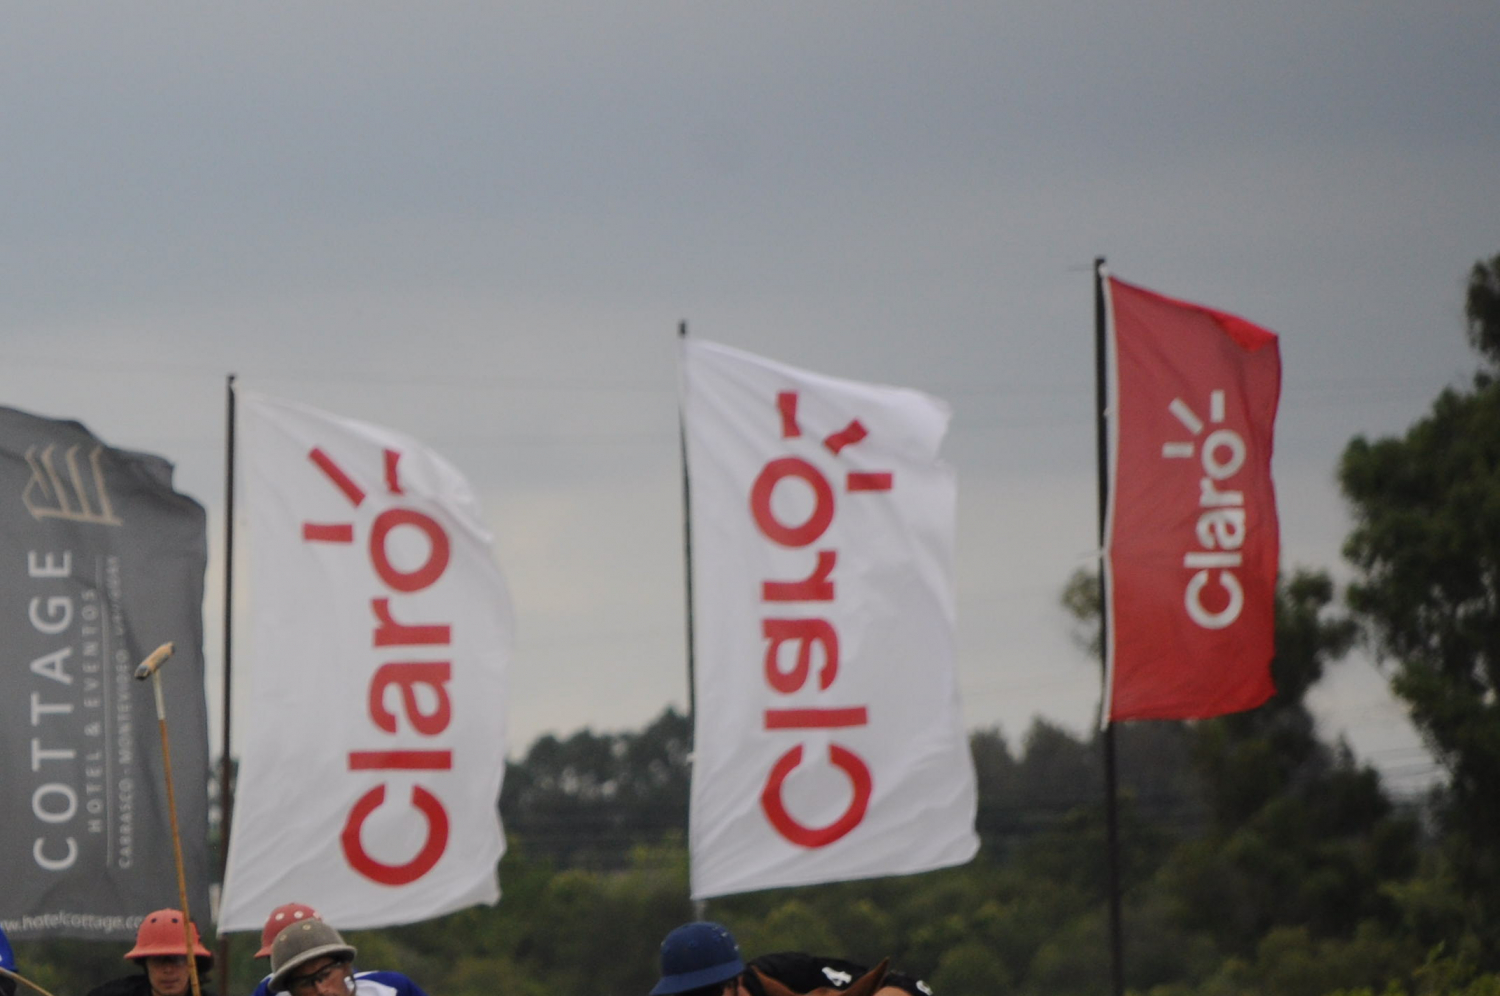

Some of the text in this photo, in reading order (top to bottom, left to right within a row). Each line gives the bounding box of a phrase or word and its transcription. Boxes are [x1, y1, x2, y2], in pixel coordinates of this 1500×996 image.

[1184, 429, 1246, 629] Claro
[29, 550, 79, 871] COTTAGE
[80, 589, 100, 707] EVENTOS
[339, 507, 452, 886] Claro
[85, 750, 103, 833] HOTEL
[118, 778, 134, 870] CARRASCO
